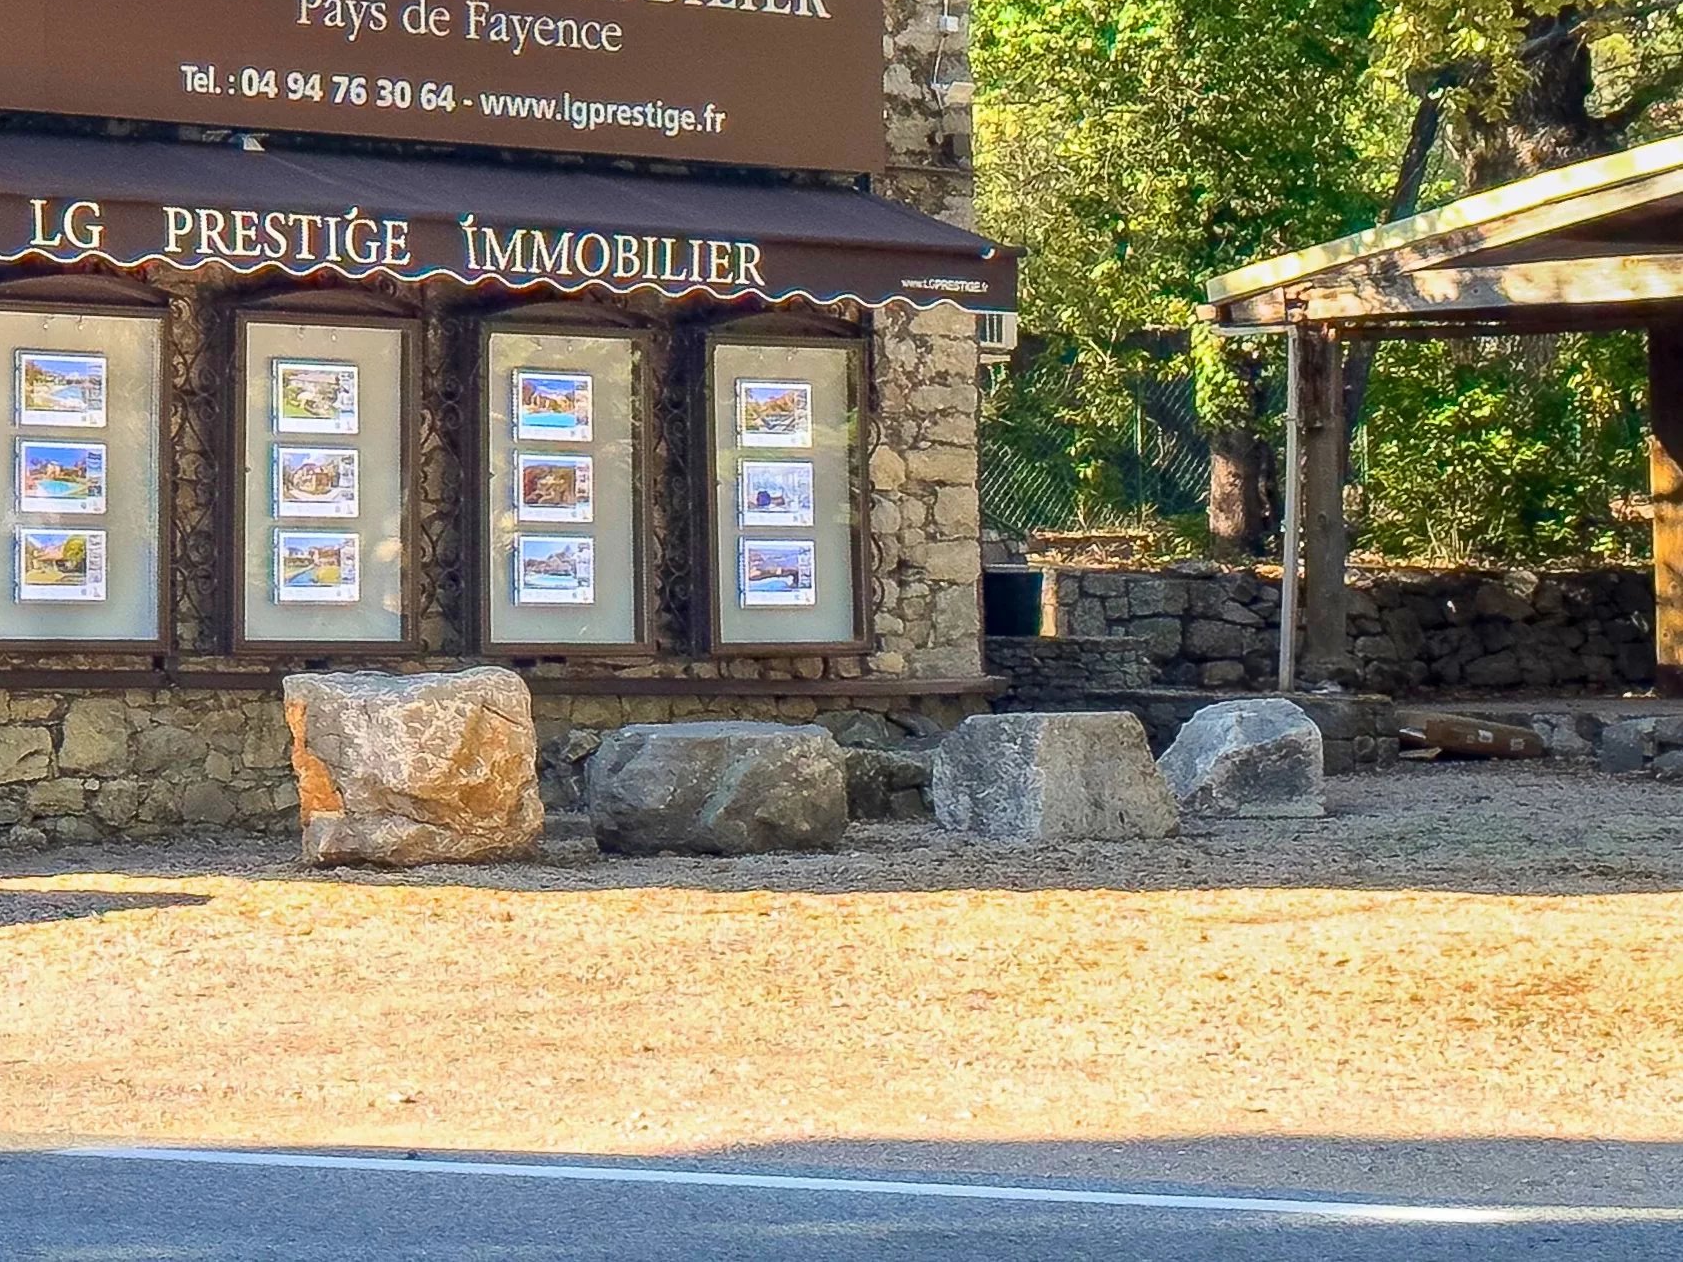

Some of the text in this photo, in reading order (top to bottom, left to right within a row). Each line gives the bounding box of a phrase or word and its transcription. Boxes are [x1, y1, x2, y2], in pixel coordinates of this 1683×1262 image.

[241, 68, 278, 99] 04
[286, 71, 323, 102] 94
[331, 75, 368, 106] 76
[375, 78, 413, 109] 30
[420, 82, 457, 113] 64
[479, 92, 727, 137] www.lgprestige.fr
[29, 198, 765, 287] LG PRESTIGE IMMOBILIER
